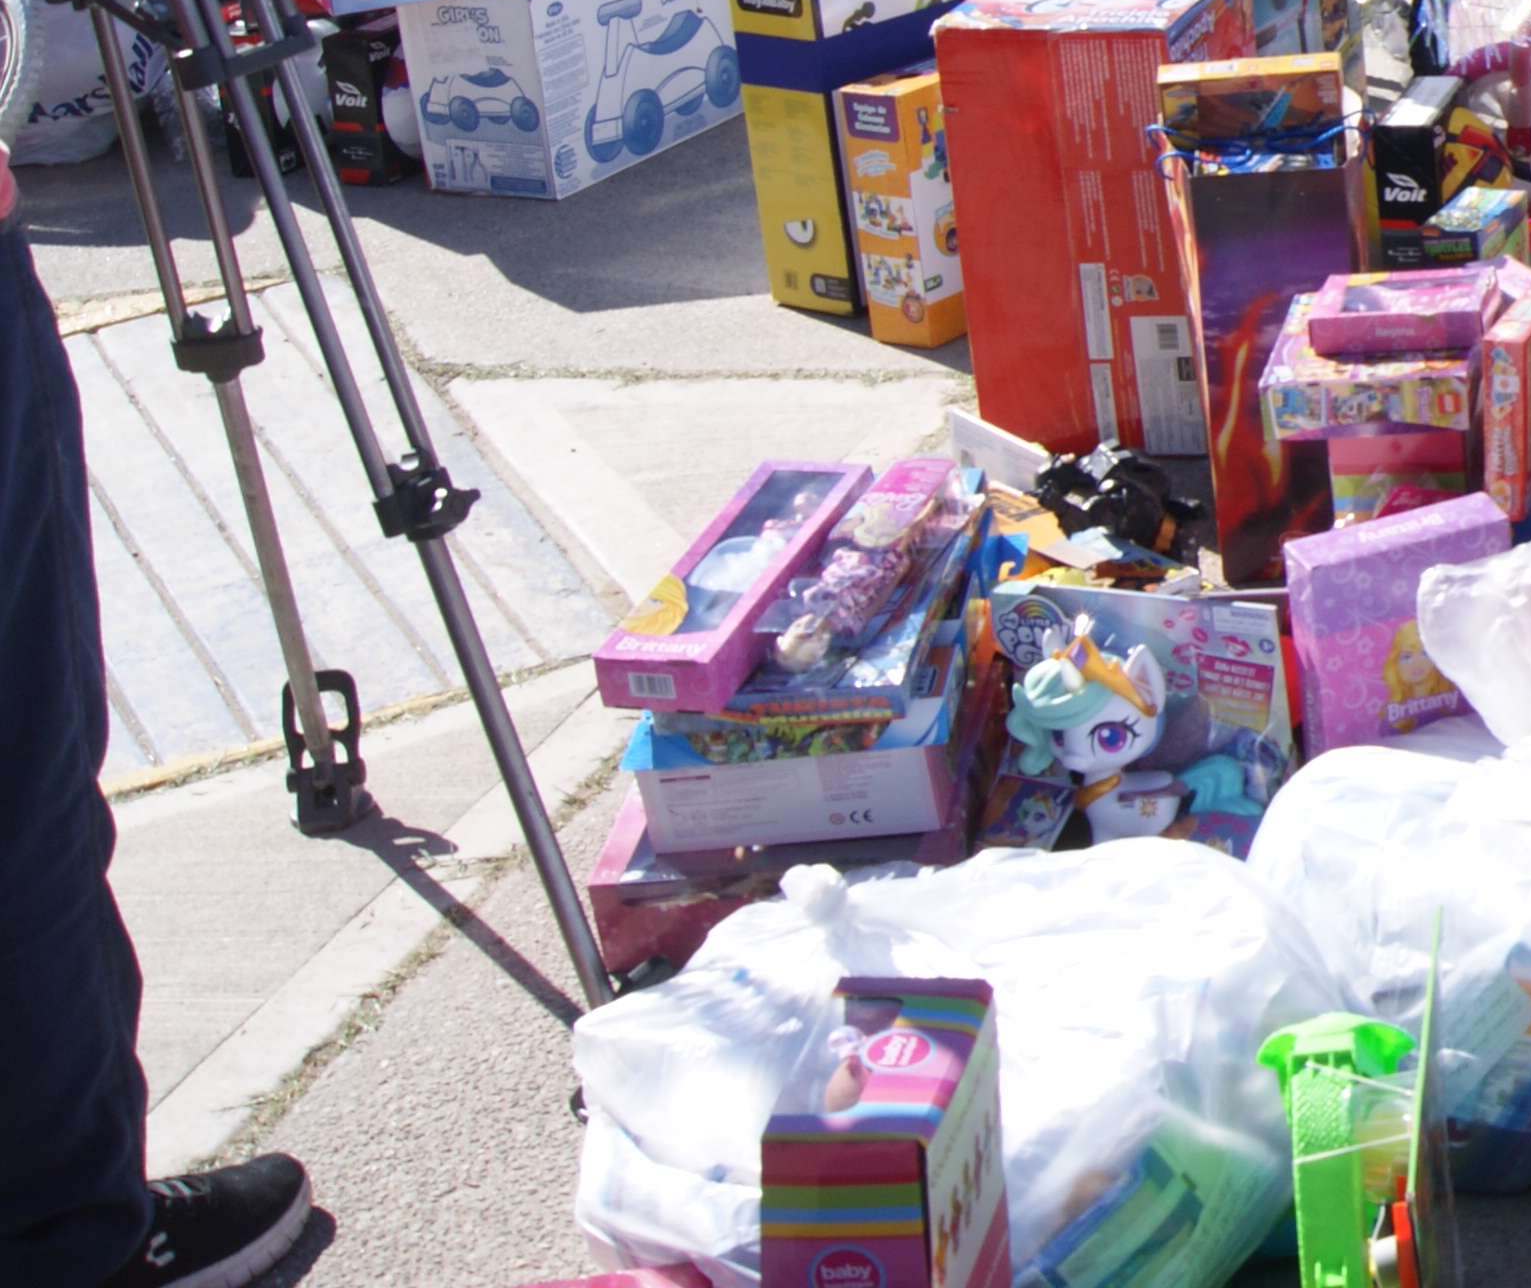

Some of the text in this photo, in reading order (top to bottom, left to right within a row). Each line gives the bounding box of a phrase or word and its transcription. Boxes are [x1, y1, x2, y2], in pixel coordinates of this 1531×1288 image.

[334, 93, 369, 109] Voit
[1383, 186, 1427, 203] Voit
[614, 634, 709, 658] Brittany
[1386, 688, 1461, 722] Brittany
[820, 1263, 872, 1282] baby
